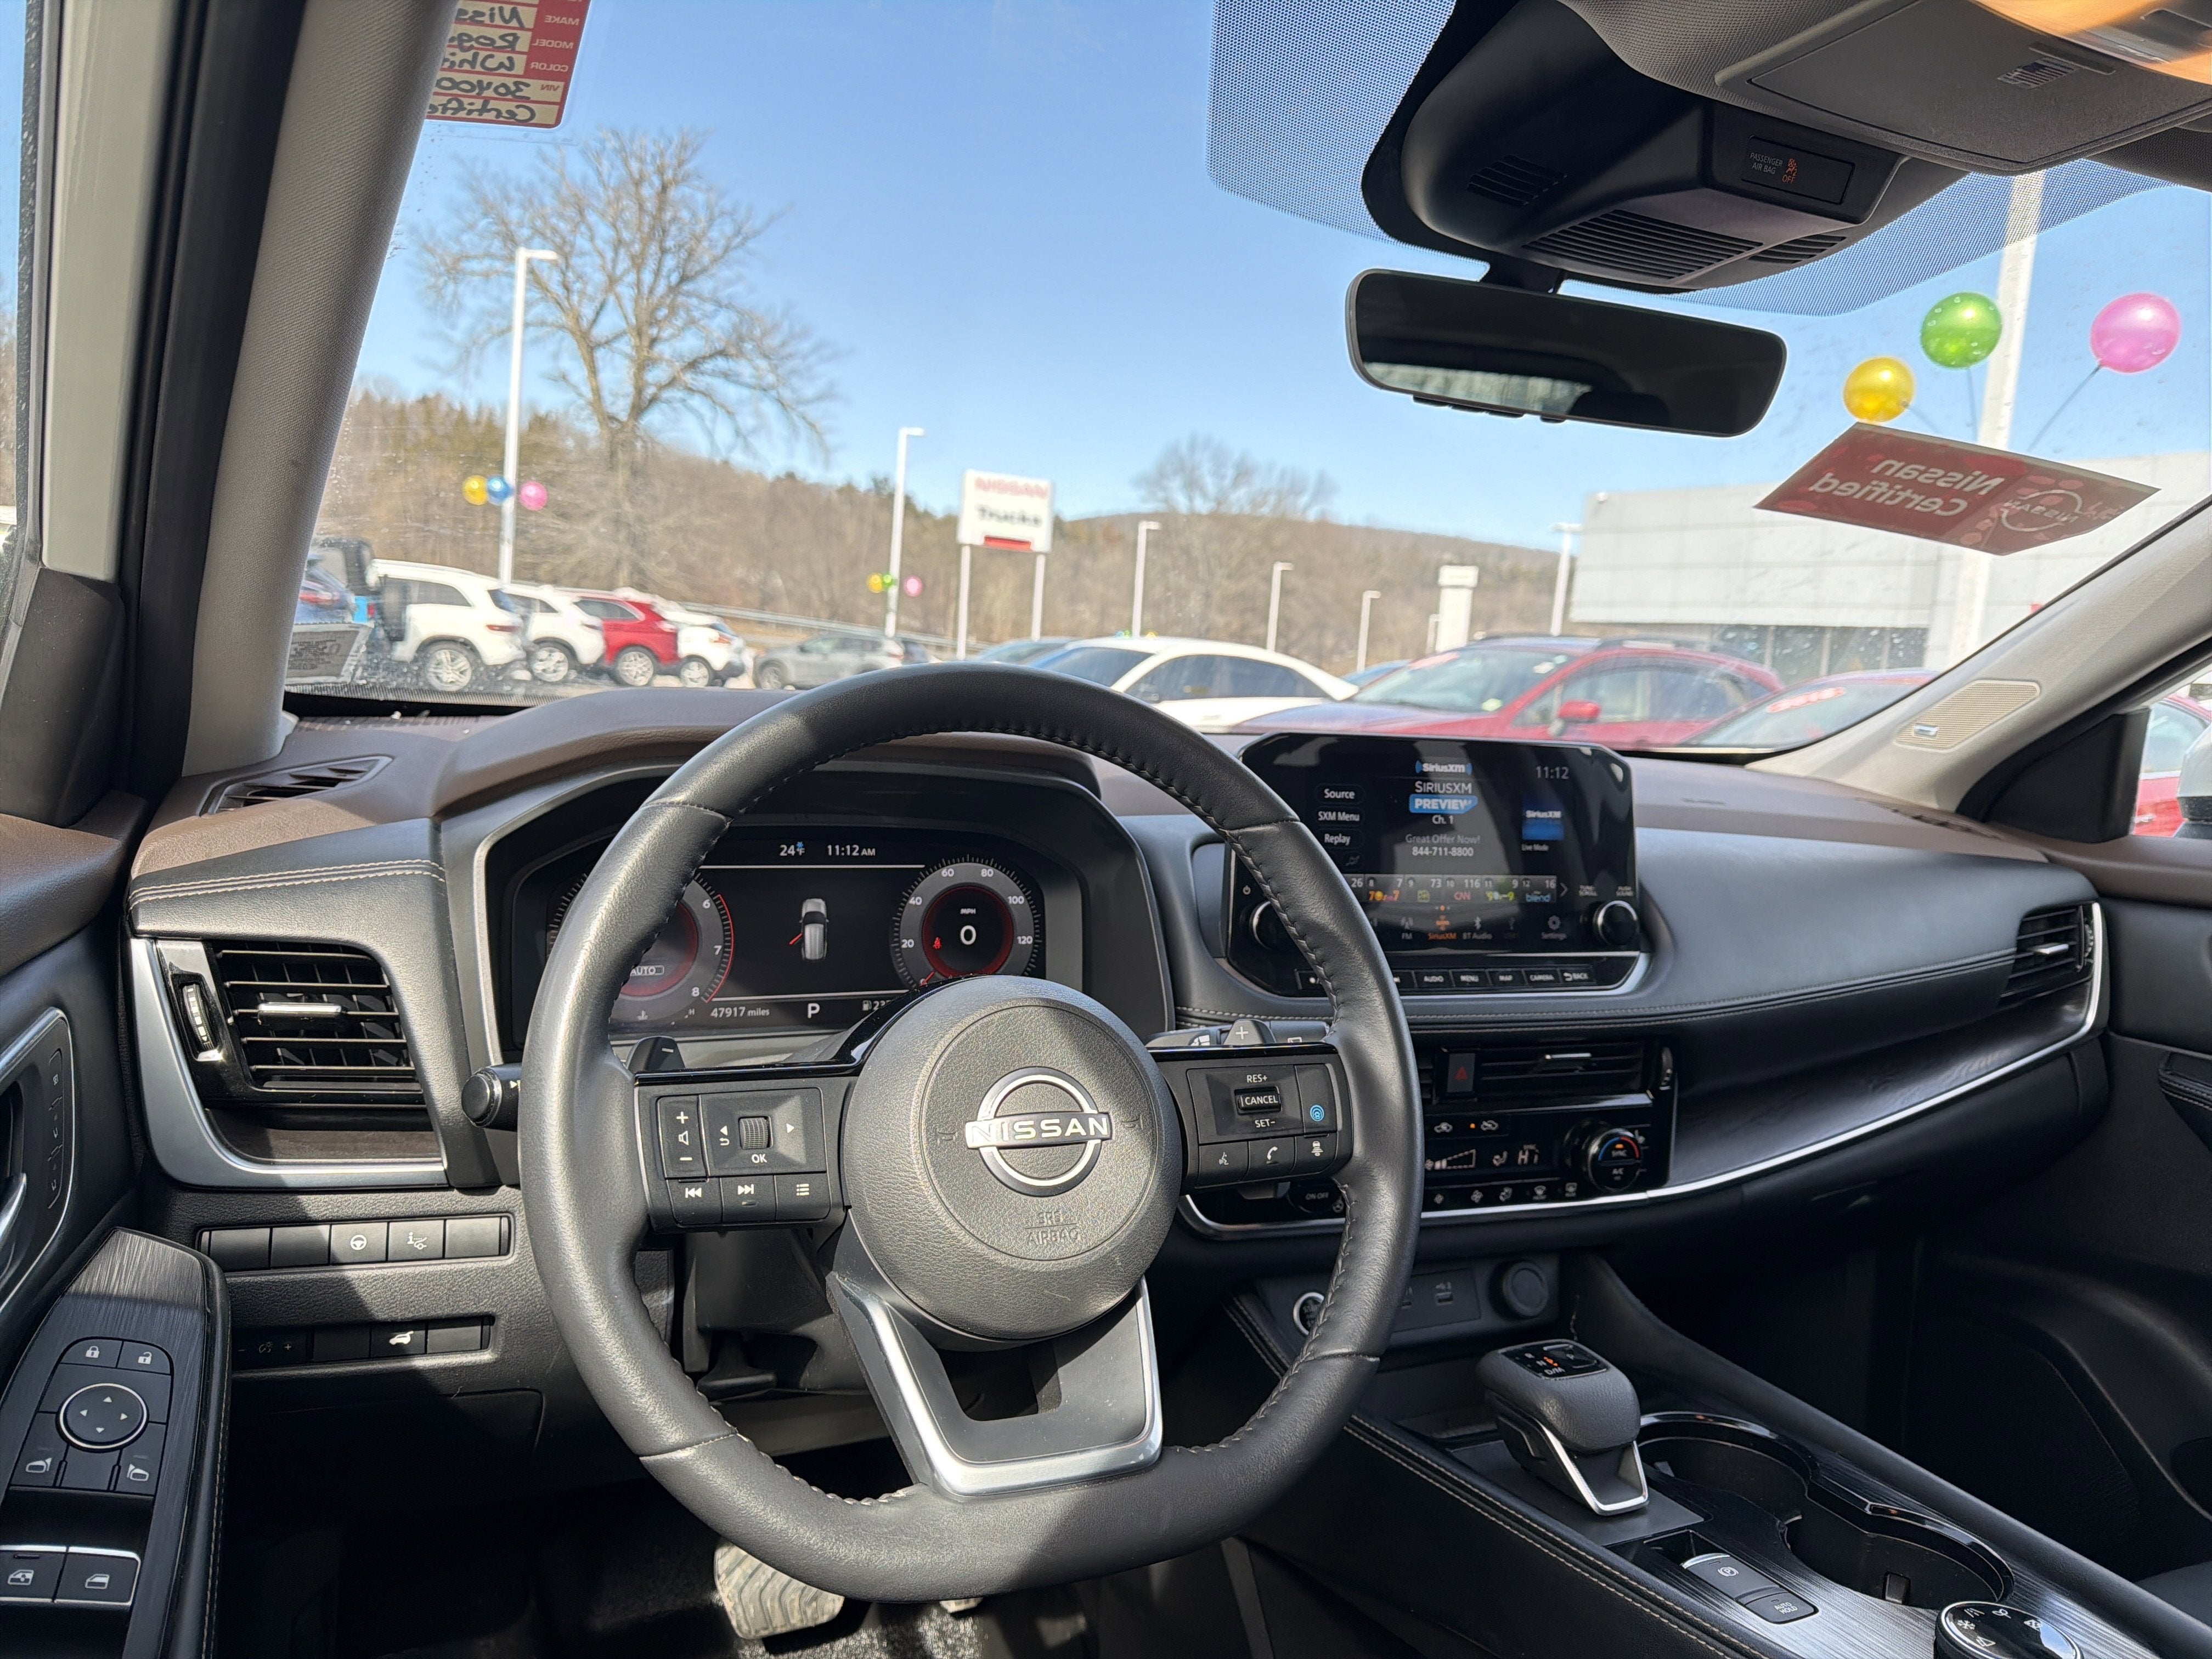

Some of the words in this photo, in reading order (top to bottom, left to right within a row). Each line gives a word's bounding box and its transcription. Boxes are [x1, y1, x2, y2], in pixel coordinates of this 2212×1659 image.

[1750, 153, 1783, 167] PASSENGER
[1752, 162, 1763, 171] AIR
[1763, 165, 1776, 174] BAG
[1782, 174, 1796, 184] OFF
[1536, 766, 1569, 780] 11:12
[1414, 781, 1472, 794] SIRIUSXM
[1324, 788, 1355, 799] Source
[1318, 811, 1336, 821] SXM
[1338, 812, 1360, 821] Menu
[1432, 815, 1447, 824] Ch.
[1448, 816, 1454, 824] 1
[1324, 833, 1351, 845] Replay
[1405, 834, 1430, 844] Great
[1431, 834, 1454, 844] Offer
[1457, 835, 1481, 844] Now!
[827, 844, 859, 856] 11:12
[1412, 847, 1474, 857] 844-711-8800
[941, 868, 955, 877] 60
[981, 868, 994, 877] 80
[1351, 878, 1364, 888] 26
[1397, 879, 1403, 888] 7
[1431, 879, 1442, 888] 73
[1464, 879, 1481, 889] 116
[1512, 879, 1519, 889] 9
[1545, 879, 1556, 889] 16
[702, 899, 711, 909] 6
[909, 896, 922, 905] 40
[1007, 896, 1025, 904] 100
[960, 925, 977, 945] 0
[901, 939, 915, 948] 20
[1017, 936, 1033, 945] 120
[714, 945, 722, 955] 7
[631, 966, 656, 975] AUTO
[691, 987, 700, 996] 8
[710, 1006, 746, 1018] 47917
[747, 1008, 770, 1017] miles
[807, 1003, 820, 1019] P
[1246, 1074, 1268, 1084] RES+
[1244, 1095, 1279, 1105] CANCEL
[970, 1116, 1109, 1143] NISSAN
[751, 1154, 768, 1164] OK
[1037, 1211, 1064, 1225] SRS
[1026, 1228, 1081, 1246] AIRBAG
[1774, 1601, 1792, 1611] AUTO
[1778, 1605, 1798, 1615] HOLD
